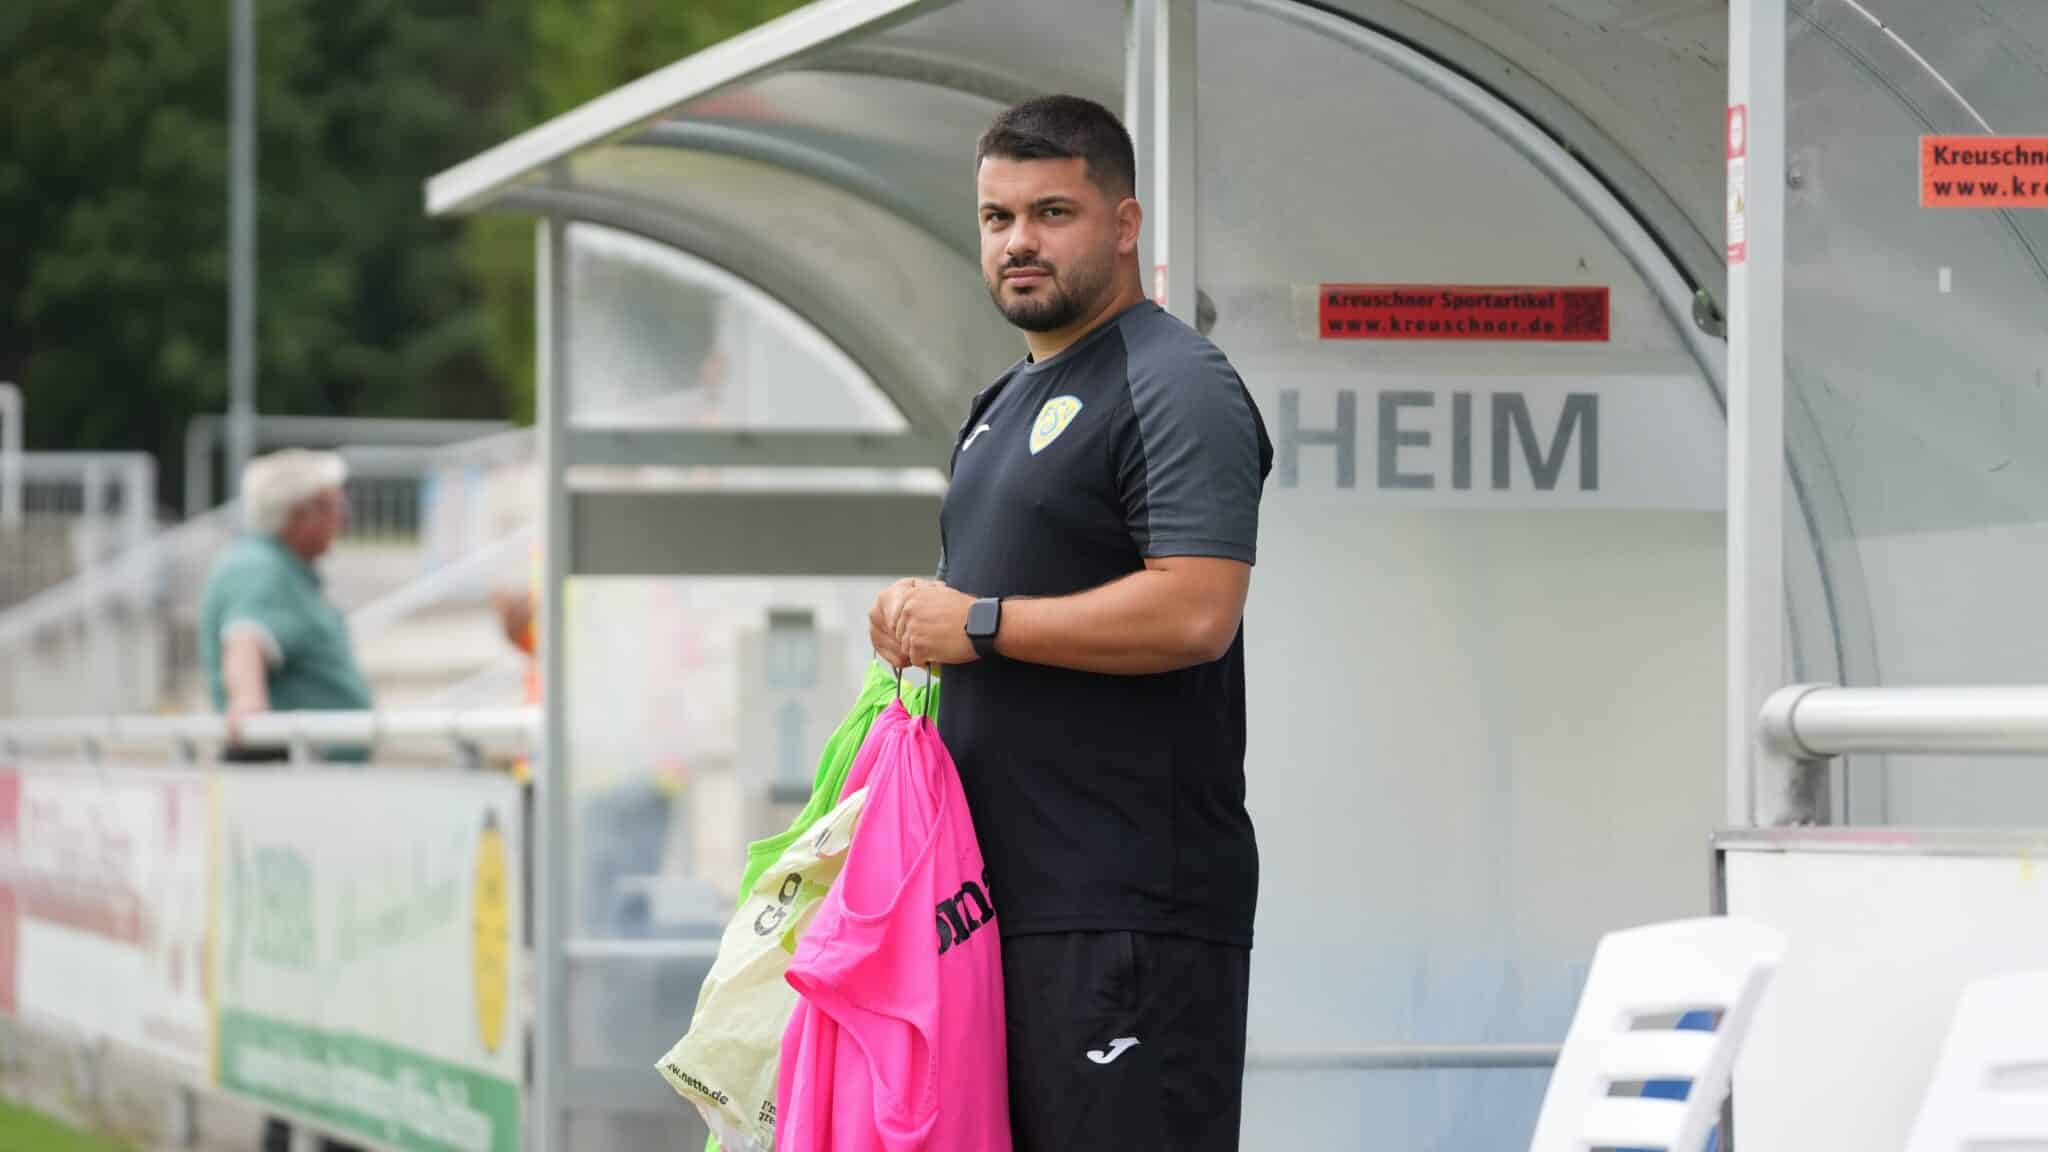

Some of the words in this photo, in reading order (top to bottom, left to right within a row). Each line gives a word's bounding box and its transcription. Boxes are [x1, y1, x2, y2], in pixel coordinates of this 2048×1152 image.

[1328, 291, 1434, 308] Kreuschner
[1441, 291, 1555, 311] Sportartikel
[1328, 314, 1555, 334] www.kreuschner.de
[1278, 388, 1599, 491] HEIM
